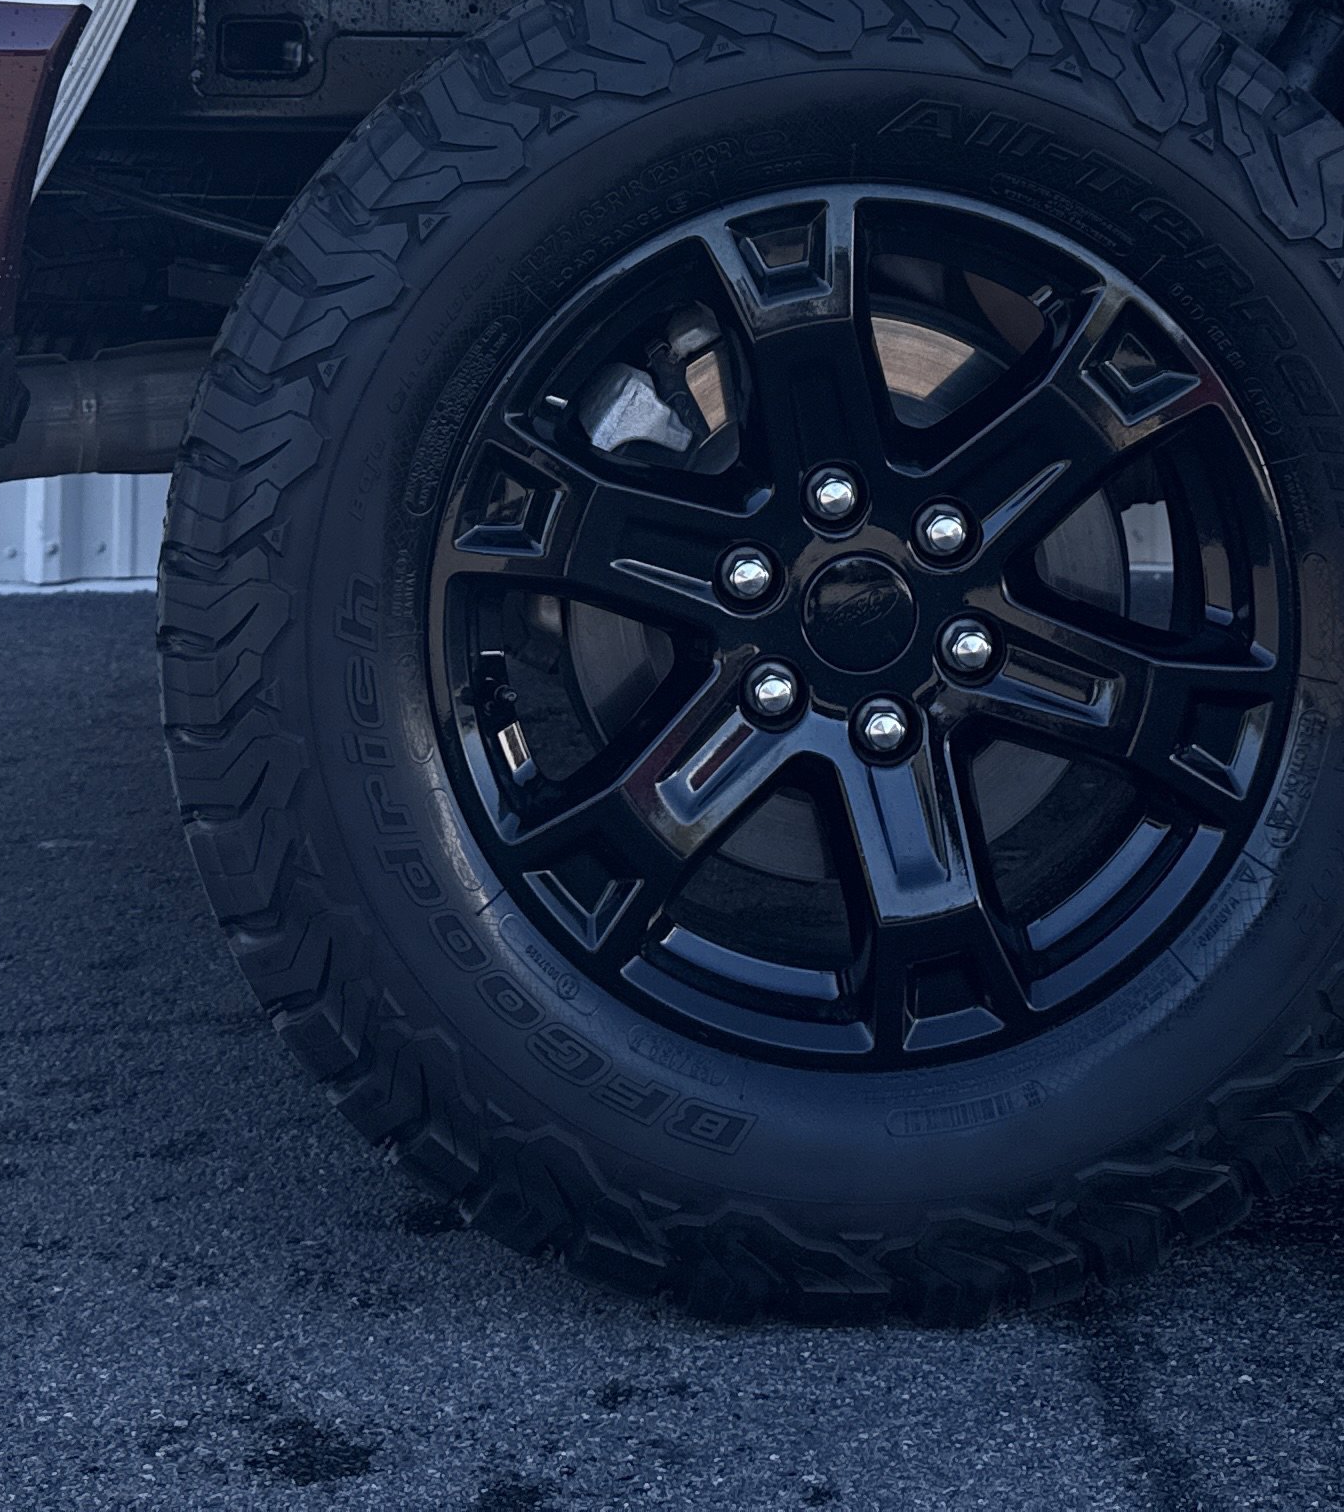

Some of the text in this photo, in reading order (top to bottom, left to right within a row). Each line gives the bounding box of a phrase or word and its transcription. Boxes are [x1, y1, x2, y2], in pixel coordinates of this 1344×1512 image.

[548, 245, 599, 290] LOAD
[597, 204, 664, 251] RANGE
[1168, 281, 1205, 320] DOT
[336, 570, 757, 1155] BFGoodrich
